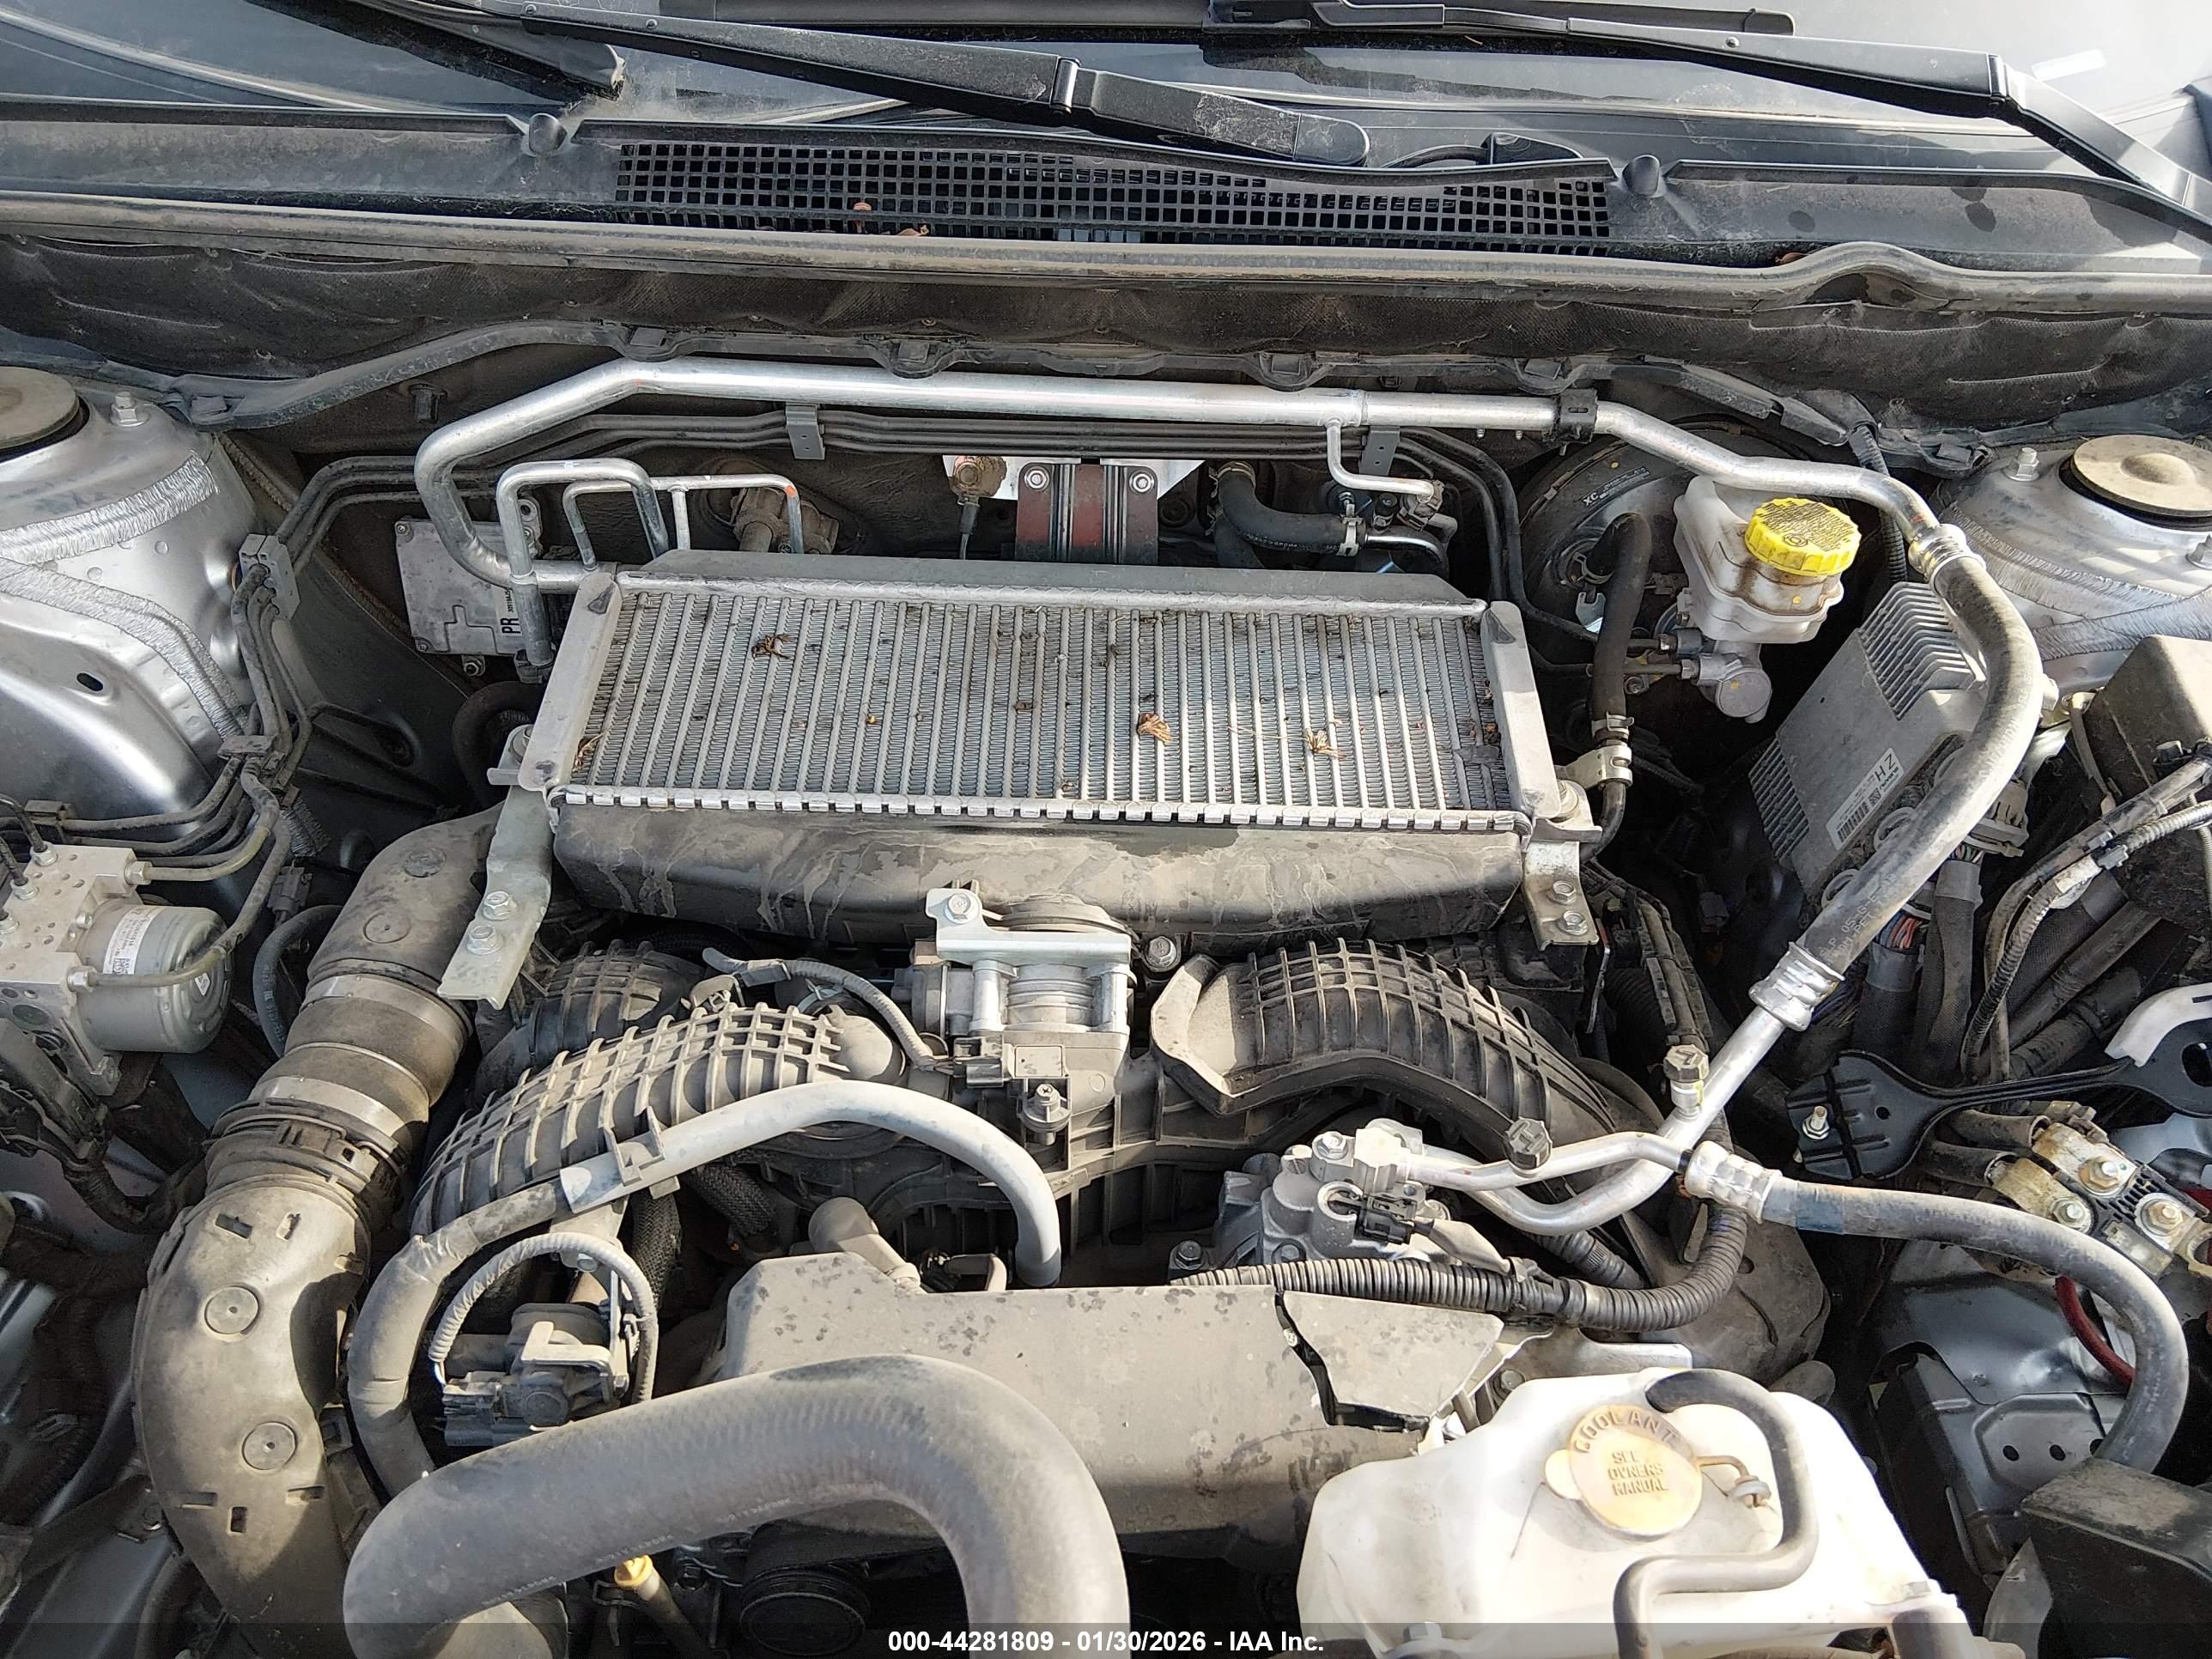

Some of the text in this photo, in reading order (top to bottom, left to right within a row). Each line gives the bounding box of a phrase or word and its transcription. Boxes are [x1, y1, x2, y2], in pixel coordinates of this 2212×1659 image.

[1583, 492, 1599, 507] XC
[500, 617, 522, 635] PR
[1573, 1410, 1677, 1454] COOLANT
[1612, 1477, 1669, 1497] MANUAL
